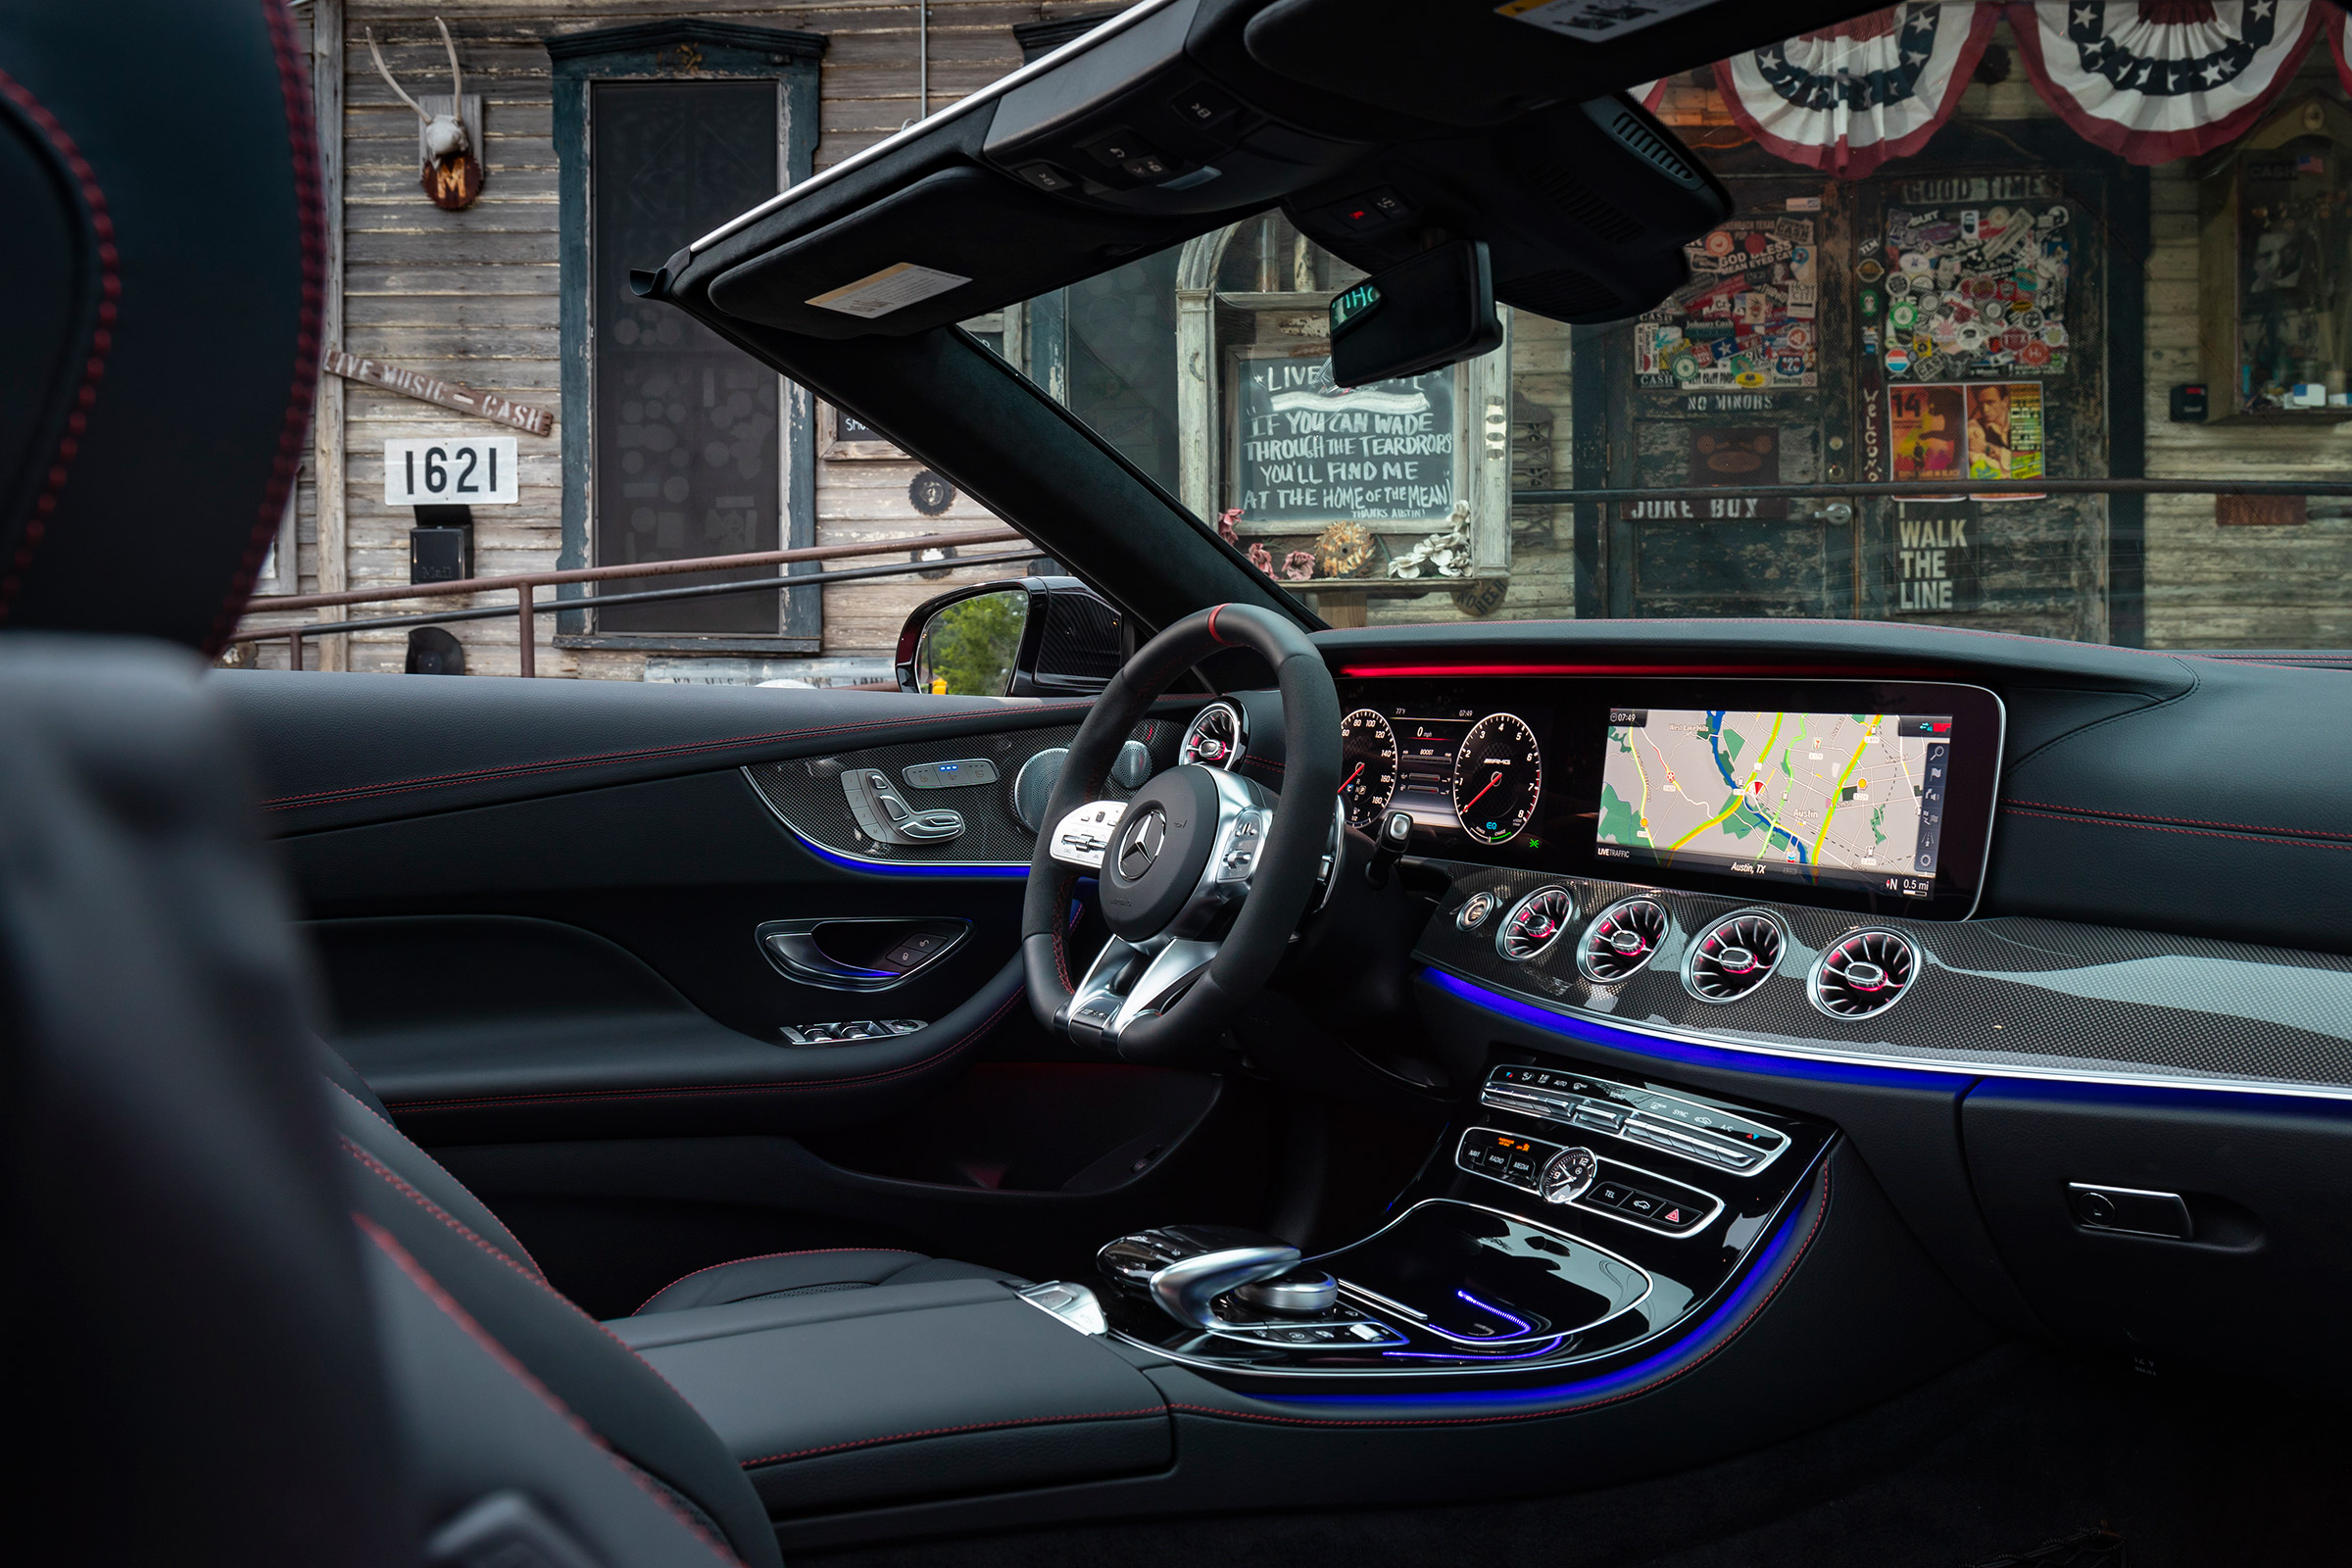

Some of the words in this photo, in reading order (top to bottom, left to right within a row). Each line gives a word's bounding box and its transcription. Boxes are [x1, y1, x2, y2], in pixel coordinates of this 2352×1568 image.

[437, 157, 466, 199] M
[1719, 252, 1747, 267] GOD
[1688, 396, 1708, 411] NO
[1715, 395, 1774, 411] MINORS
[1891, 393, 1922, 417] 14
[481, 394, 540, 432] CASH
[1285, 411, 1324, 434] YOU
[1328, 412, 1368, 433] CAN
[1374, 412, 1434, 435] WADE
[1244, 436, 1325, 463] THROUGH
[1326, 437, 1356, 456] THE
[1358, 433, 1452, 458] TEARDROPS
[405, 447, 498, 496] 1621
[1260, 460, 1323, 486] YOU'LL
[1327, 461, 1378, 483] FIND
[1382, 461, 1419, 481] ME
[1244, 489, 1270, 511] AT
[1277, 487, 1318, 509] THE
[1323, 486, 1366, 510] HOME
[1366, 489, 1382, 504] OF
[1384, 486, 1406, 504] THE
[1350, 508, 1389, 518] THANKS
[1709, 498, 1758, 518] BOX
[1899, 518, 1968, 548] WALK
[1899, 550, 1947, 578] THE
[1475, 578, 1506, 614] BEER
[1900, 580, 1953, 610] LINE
[1617, 712, 1637, 722] 07:49
[1416, 726, 1424, 737] 0
[1515, 732, 1523, 741] 5
[1526, 753, 1534, 761] 6
[1528, 782, 1535, 792] 7
[1517, 809, 1525, 818] 8
[1793, 808, 1819, 819] Austin
[1486, 821, 1497, 830] EQ
[1731, 861, 1754, 874] Austin,
[1756, 864, 1767, 874] TX
[1889, 879, 1898, 891] N
[1903, 879, 1917, 890] 0.5
[1918, 880, 1930, 891] mi
[1672, 1108, 1690, 1118] SYNC
[1489, 1153, 1504, 1165] RADIO
[1578, 1156, 1590, 1166] 12
[1512, 1160, 1530, 1172] MEDIA
[1604, 1189, 1615, 1200] TEL
